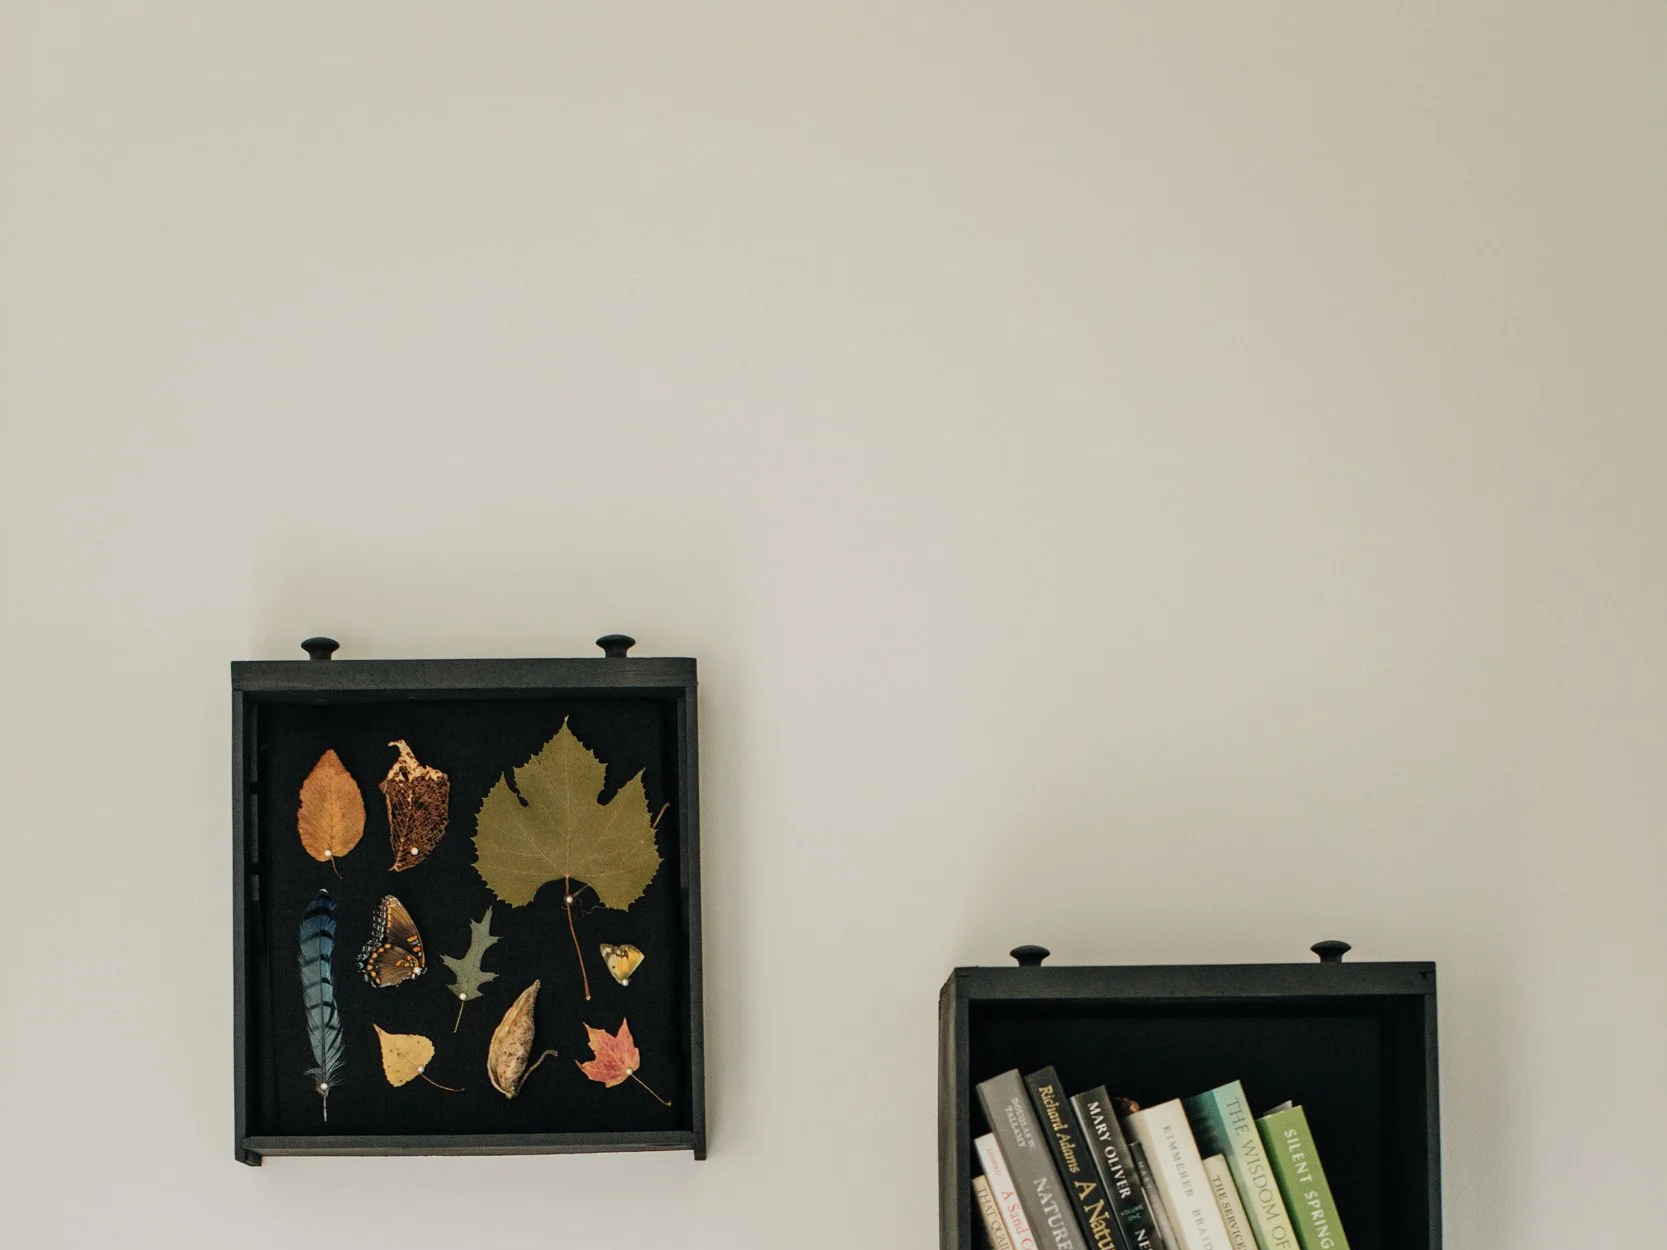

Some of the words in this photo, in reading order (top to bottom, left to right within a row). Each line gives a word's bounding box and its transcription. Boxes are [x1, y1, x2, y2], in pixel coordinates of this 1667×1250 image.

[1005, 1105, 1026, 1147] TALLAMY
[1038, 1085, 1068, 1131] Richard
[1056, 1133, 1080, 1173] Adams
[1087, 1101, 1112, 1141] MARY
[1104, 1146, 1132, 1199] OLIVER
[1163, 1125, 1194, 1200] KIMMERER
[1074, 1181, 1098, 1200] A
[1212, 1175, 1228, 1200] THE
[1226, 1097, 1250, 1136] THE
[1242, 1140, 1280, 1221] WISDOM
[1272, 1225, 1291, 1248] OF
[1284, 1128, 1312, 1184] SILENT
[1304, 1191, 1334, 1250] SPRING
[978, 1187, 996, 1217] THAT
[1001, 1191, 1014, 1201] A
[1007, 1203, 1030, 1235] Sand
